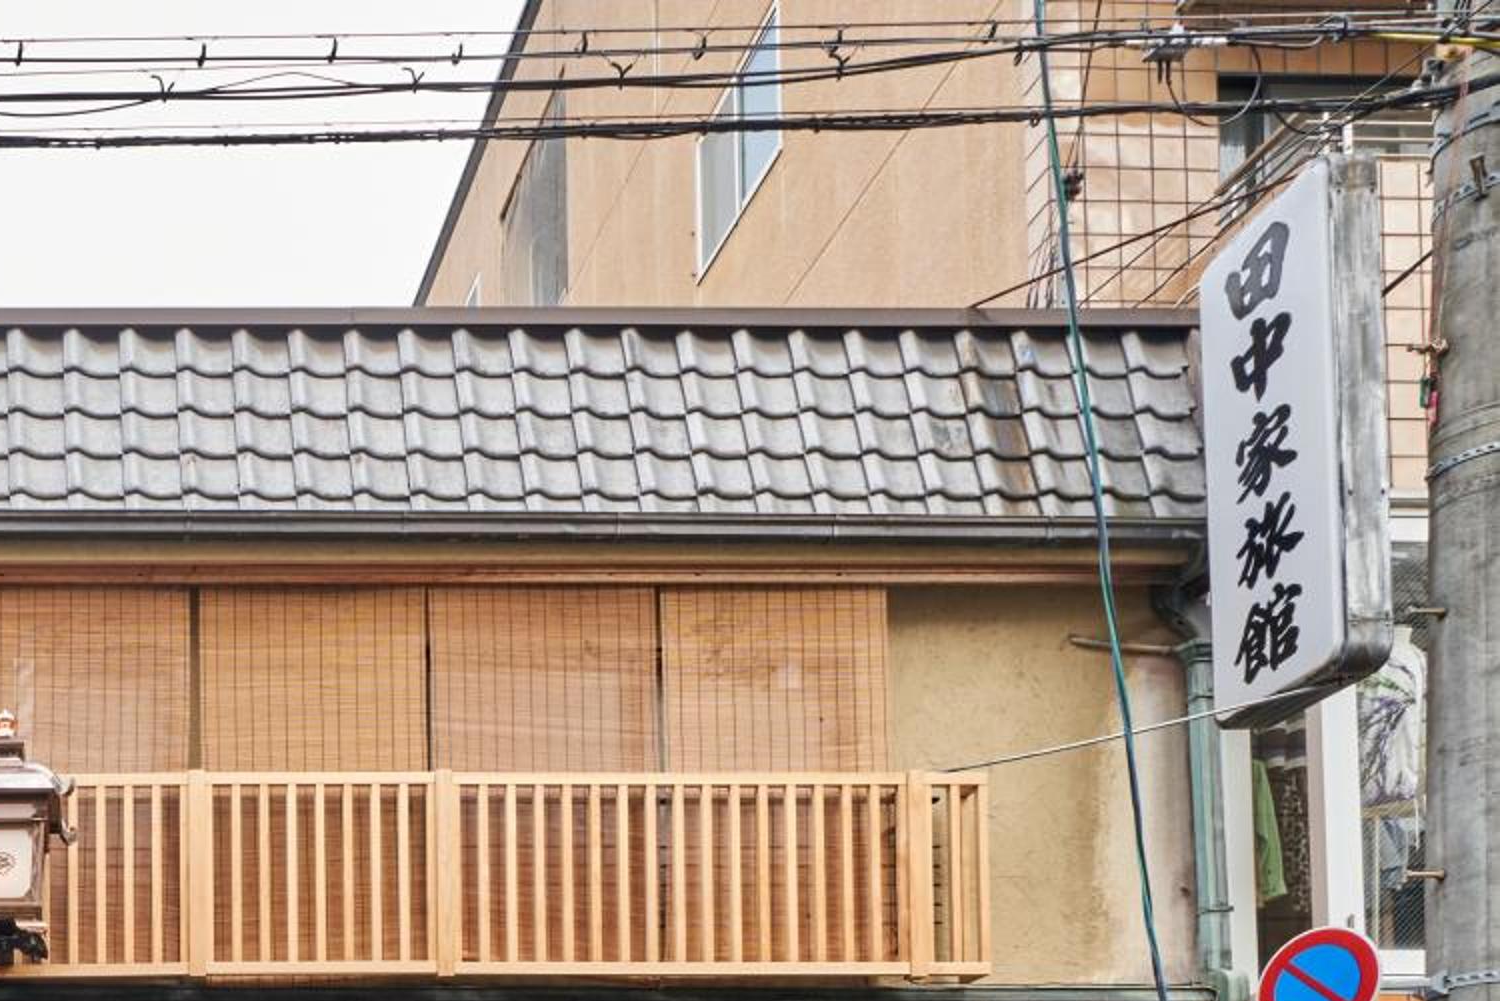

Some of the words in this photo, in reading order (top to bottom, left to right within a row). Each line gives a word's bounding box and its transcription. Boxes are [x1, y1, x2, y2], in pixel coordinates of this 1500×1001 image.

[1225, 221, 1303, 684] 田中家旅館
